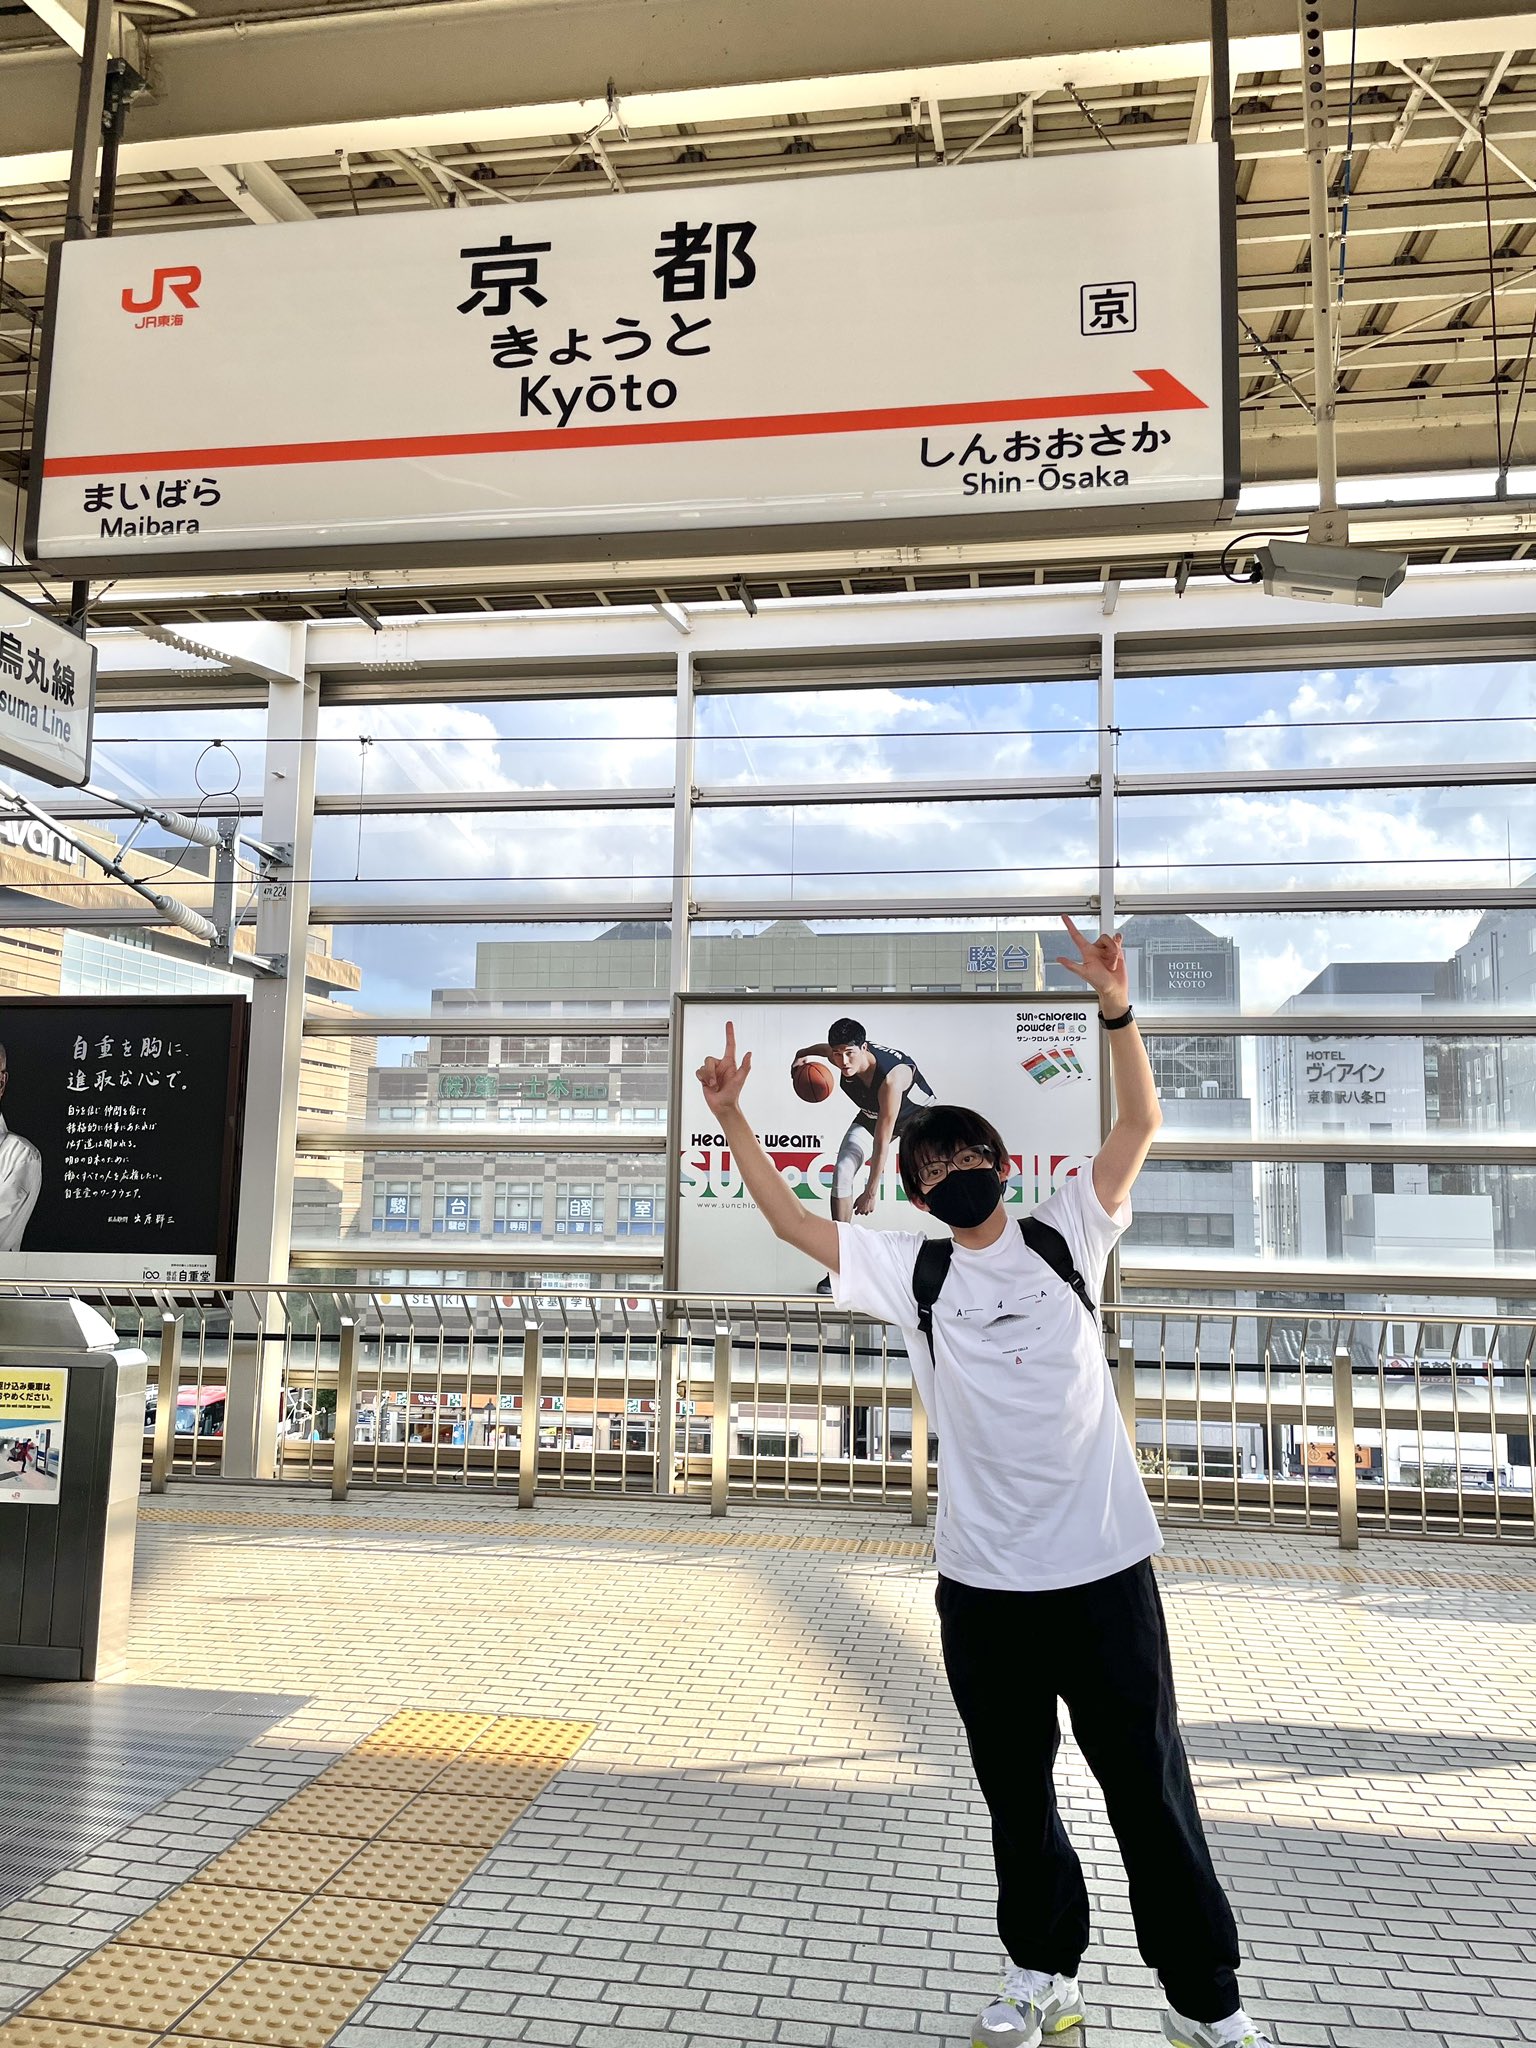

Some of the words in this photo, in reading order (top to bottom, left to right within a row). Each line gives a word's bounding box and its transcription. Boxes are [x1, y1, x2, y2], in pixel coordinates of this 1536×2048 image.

[121, 266, 202, 313] JR
[134, 313, 184, 329] JR東海
[1088, 288, 1130, 330] 京
[490, 313, 711, 369] きょうと
[519, 374, 678, 427] Kyōto
[920, 420, 1171, 468] しんおおさか
[82, 477, 222, 513] まいばら
[100, 514, 200, 539] Maibara
[42, 704, 71, 742] Line
[273, 886, 287, 897] 224
[967, 944, 1030, 972] 駿台
[1168, 962, 1203, 970] HOTEL
[1169, 971, 1213, 979] VISCHIO
[1169, 980, 1206, 989] KYOTO
[1306, 1051, 1346, 1061] HOTEL
[1306, 1062, 1385, 1083] ヴィアイン
